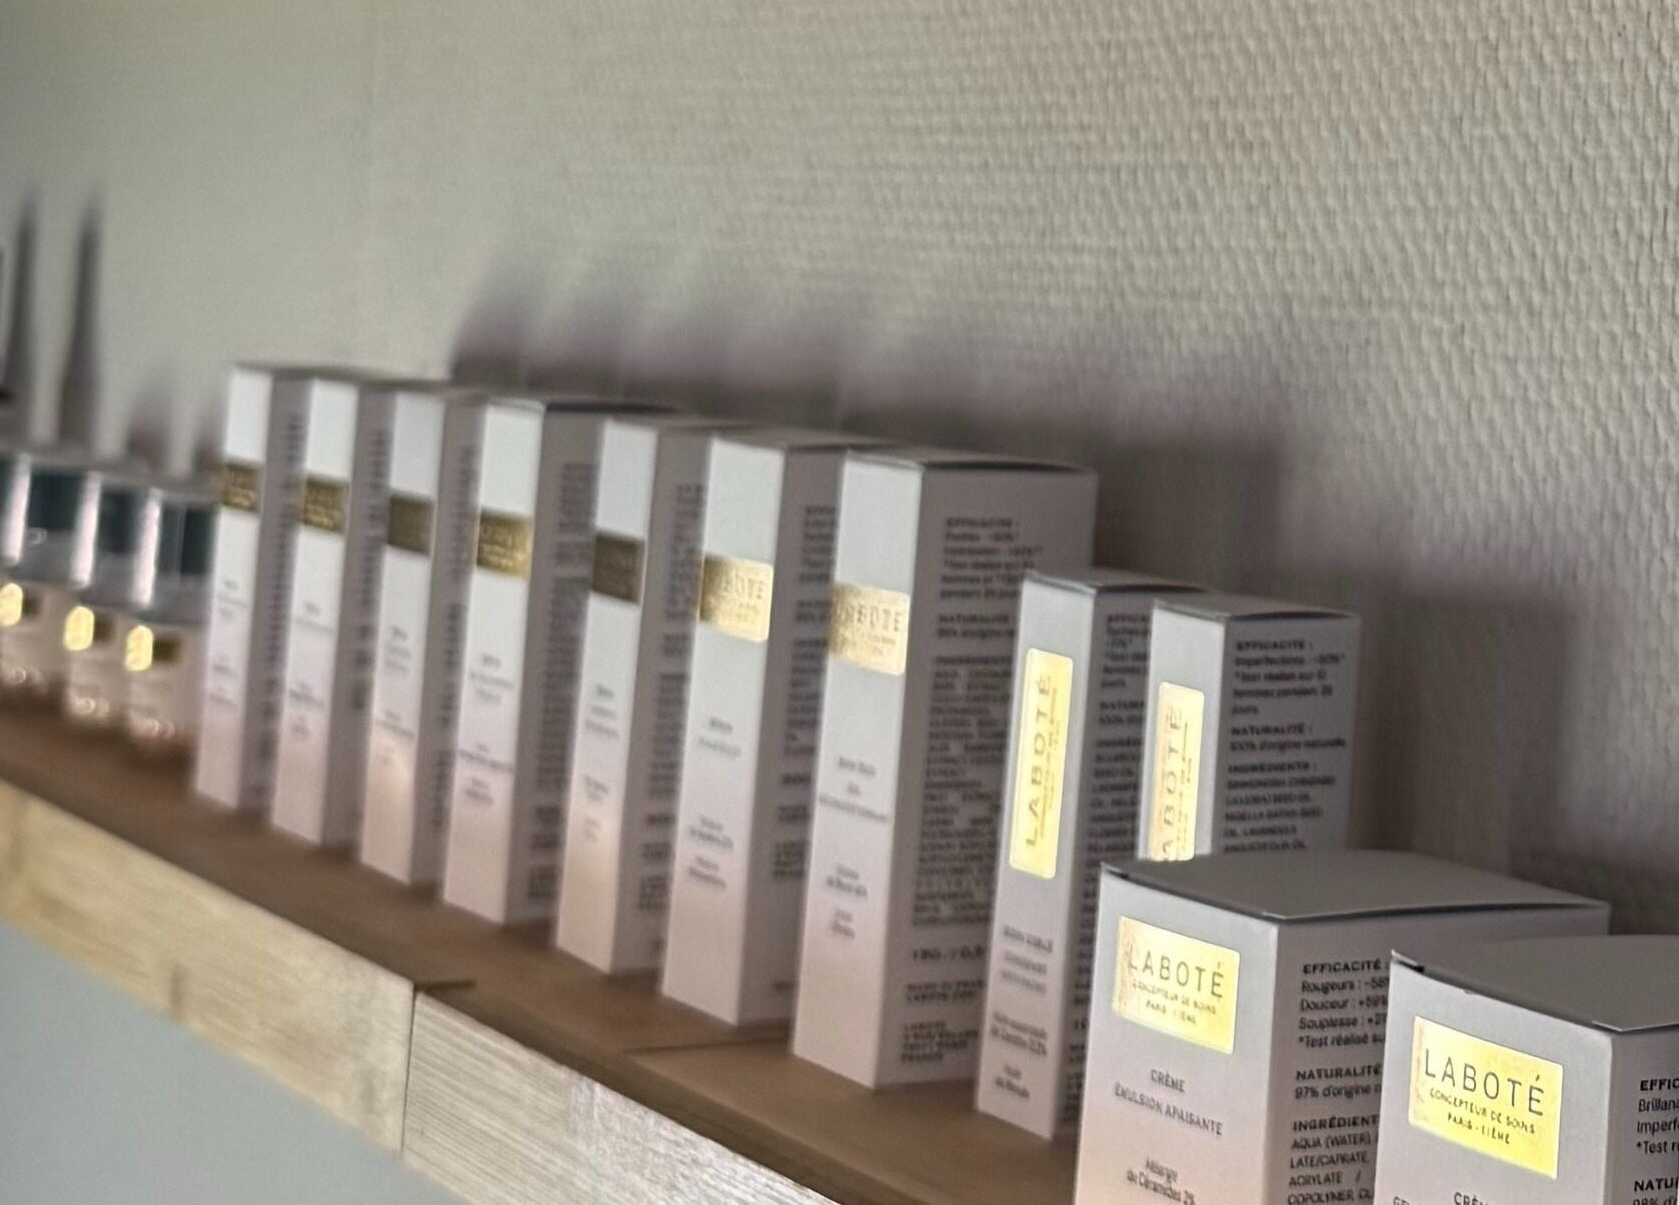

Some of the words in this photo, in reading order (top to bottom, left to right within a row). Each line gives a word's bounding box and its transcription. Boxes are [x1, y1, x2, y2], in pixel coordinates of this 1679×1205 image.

[1129, 944, 1225, 999] LABOTÉ
[1303, 958, 1382, 975] EFFICACITÉ
[1151, 1069, 1186, 1093] CRÈME
[1425, 1048, 1545, 1117] LABOTÉ
